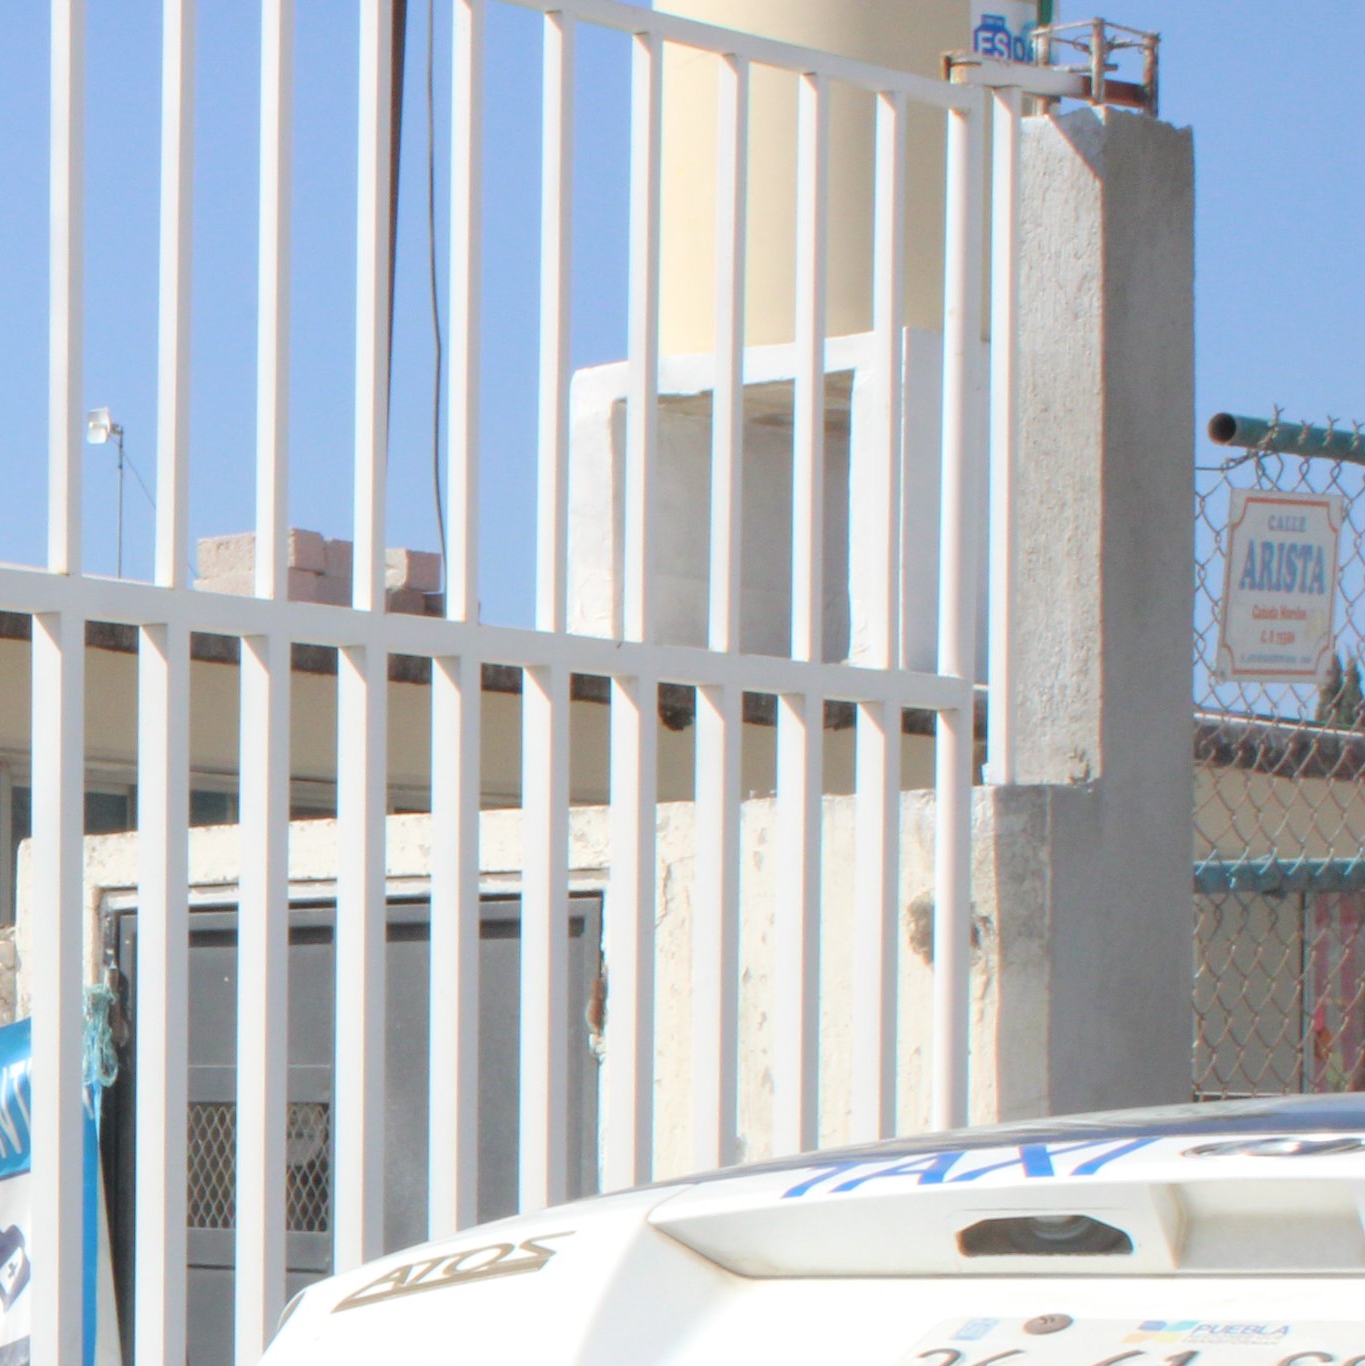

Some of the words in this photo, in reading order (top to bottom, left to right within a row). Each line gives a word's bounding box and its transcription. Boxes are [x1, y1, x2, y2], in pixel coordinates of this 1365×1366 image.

[1268, 514, 1307, 533] CALLE
[1239, 538, 1325, 595] ARISTA
[781, 1137, 1162, 1198] TAXI
[334, 1230, 577, 1310] ATOS
[1191, 1323, 1290, 1336] PUEBLA
